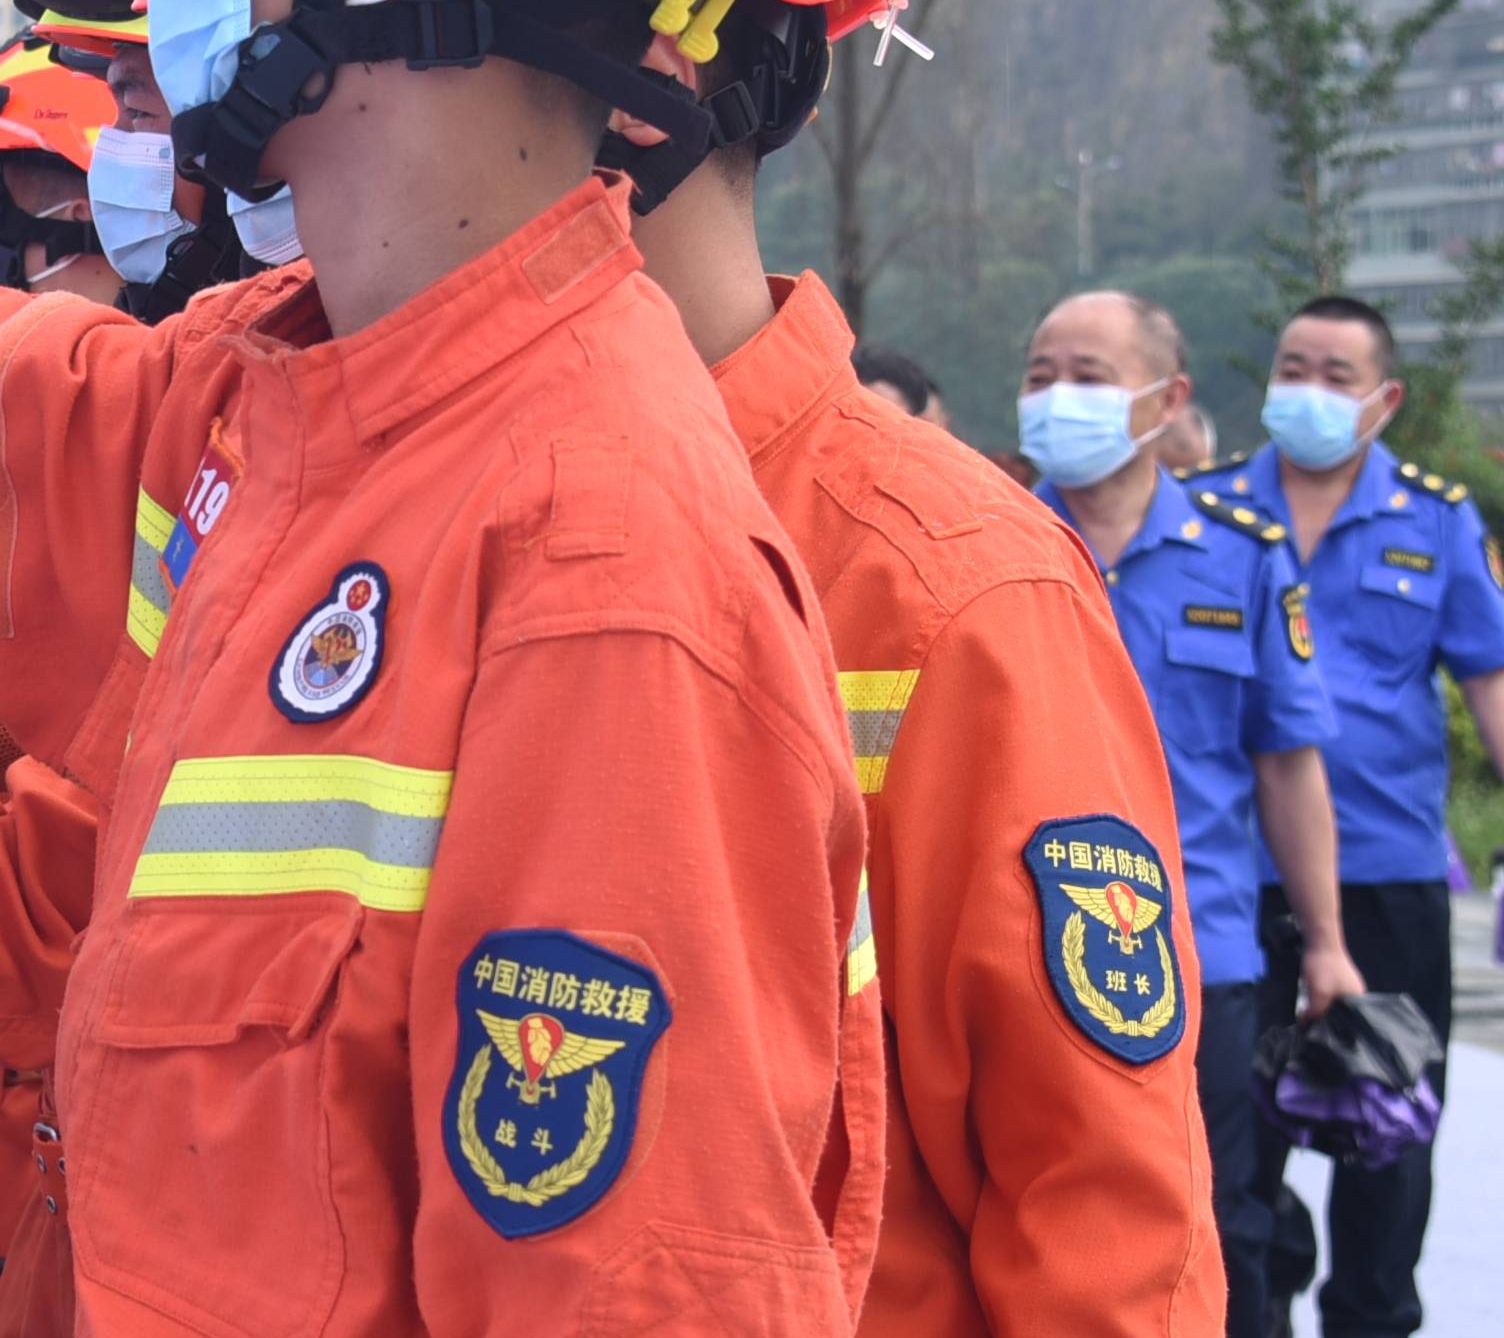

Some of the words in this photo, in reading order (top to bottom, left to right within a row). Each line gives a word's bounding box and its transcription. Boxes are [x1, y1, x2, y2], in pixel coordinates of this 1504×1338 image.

[1044, 838, 1164, 892] 中国消防救援
[473, 953, 652, 1026] 中国消防救援
[1105, 969, 1152, 996] 班长
[494, 1118, 553, 1156] 战斗
